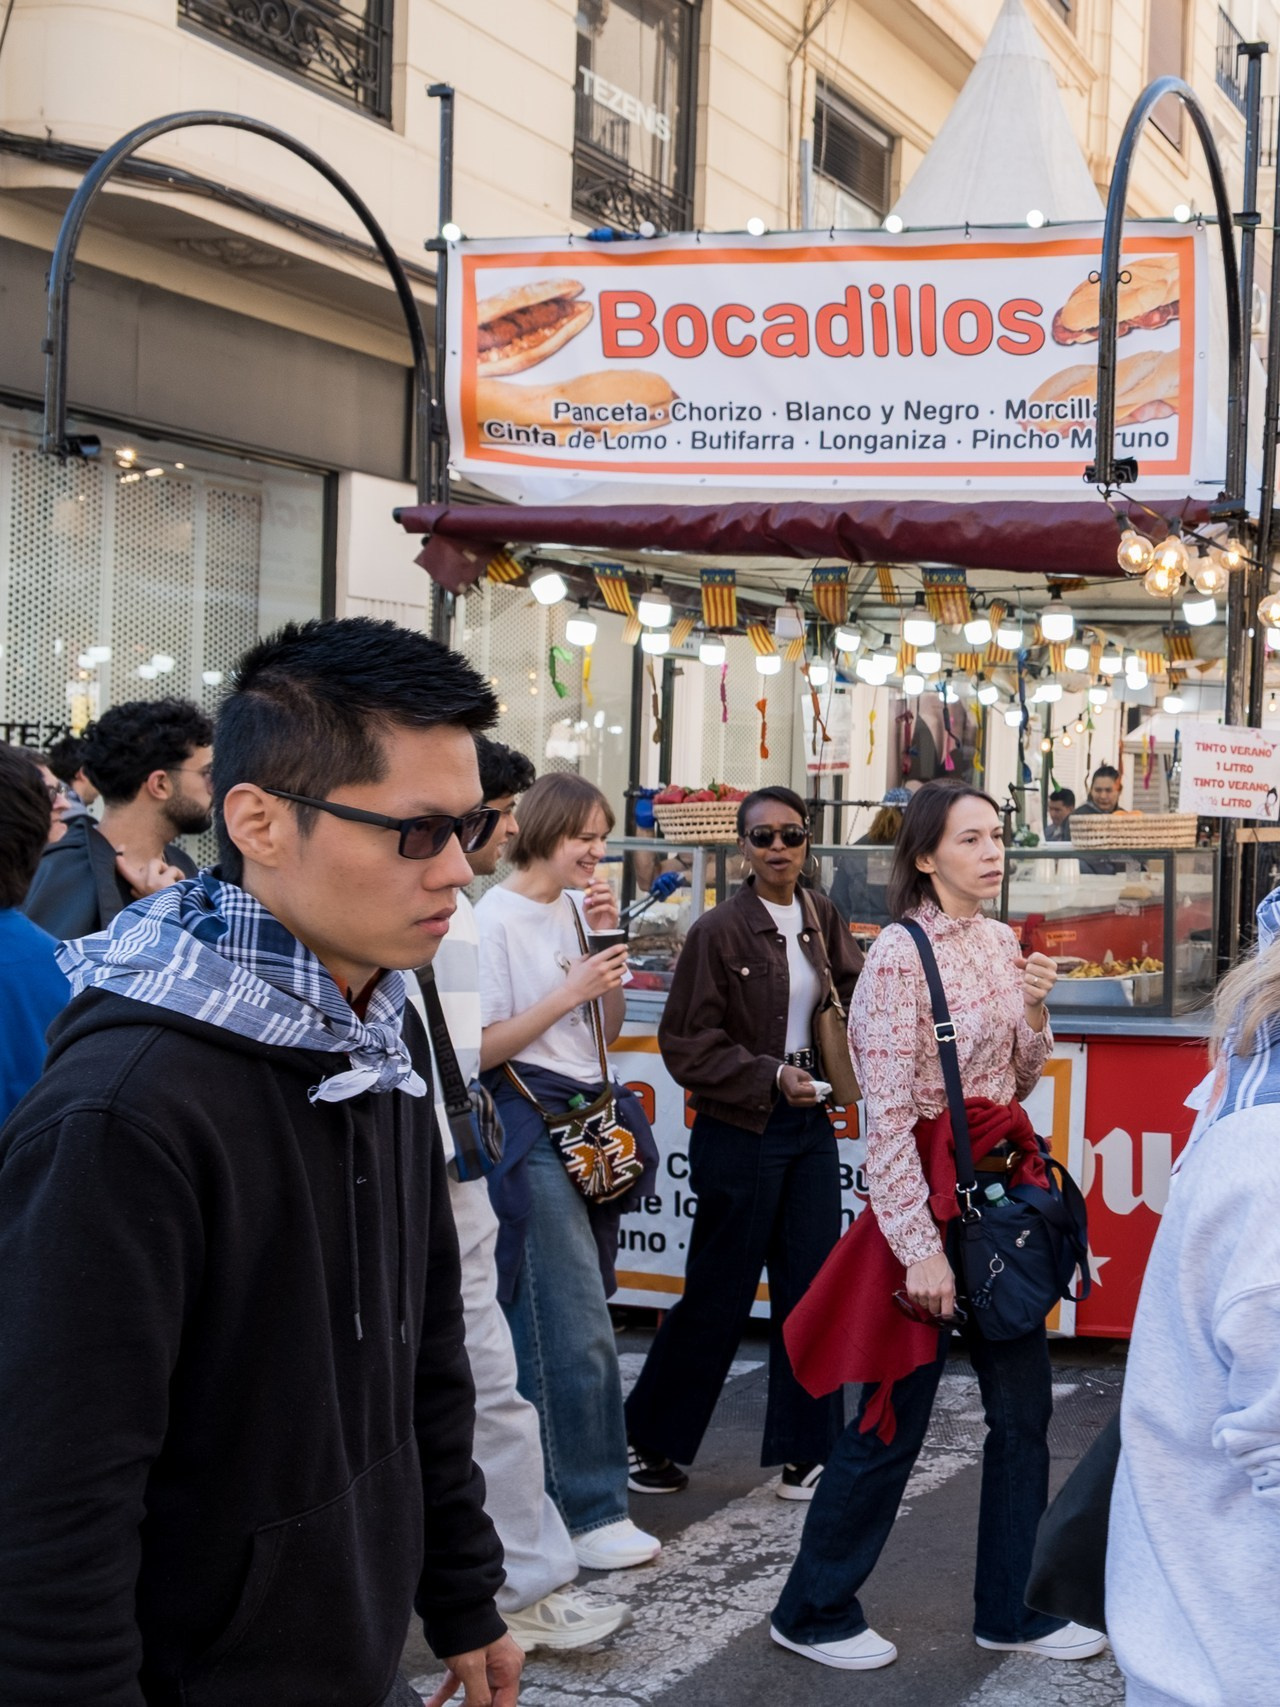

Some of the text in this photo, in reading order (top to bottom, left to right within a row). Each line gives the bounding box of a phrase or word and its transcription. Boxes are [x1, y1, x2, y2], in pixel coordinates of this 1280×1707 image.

[598, 283, 1047, 361] Bocadillos
[553, 401, 648, 422] Panceta
[671, 400, 762, 422] Chorizo
[786, 400, 871, 421] Blanco
[881, 404, 895, 424] y
[903, 400, 980, 424] Negro
[485, 422, 557, 447] Cinta
[568, 431, 596, 449] de
[603, 431, 668, 450] Lomo
[691, 431, 795, 450] Butifarra
[819, 429, 947, 454] Longaniza
[972, 429, 1060, 449] Pincho
[1195, 742, 1272, 758] TINTO VERANO
[1223, 763, 1254, 774] LITRO
[1194, 778, 1270, 792] TINTO VERANO
[1221, 798, 1252, 808] LITRO
